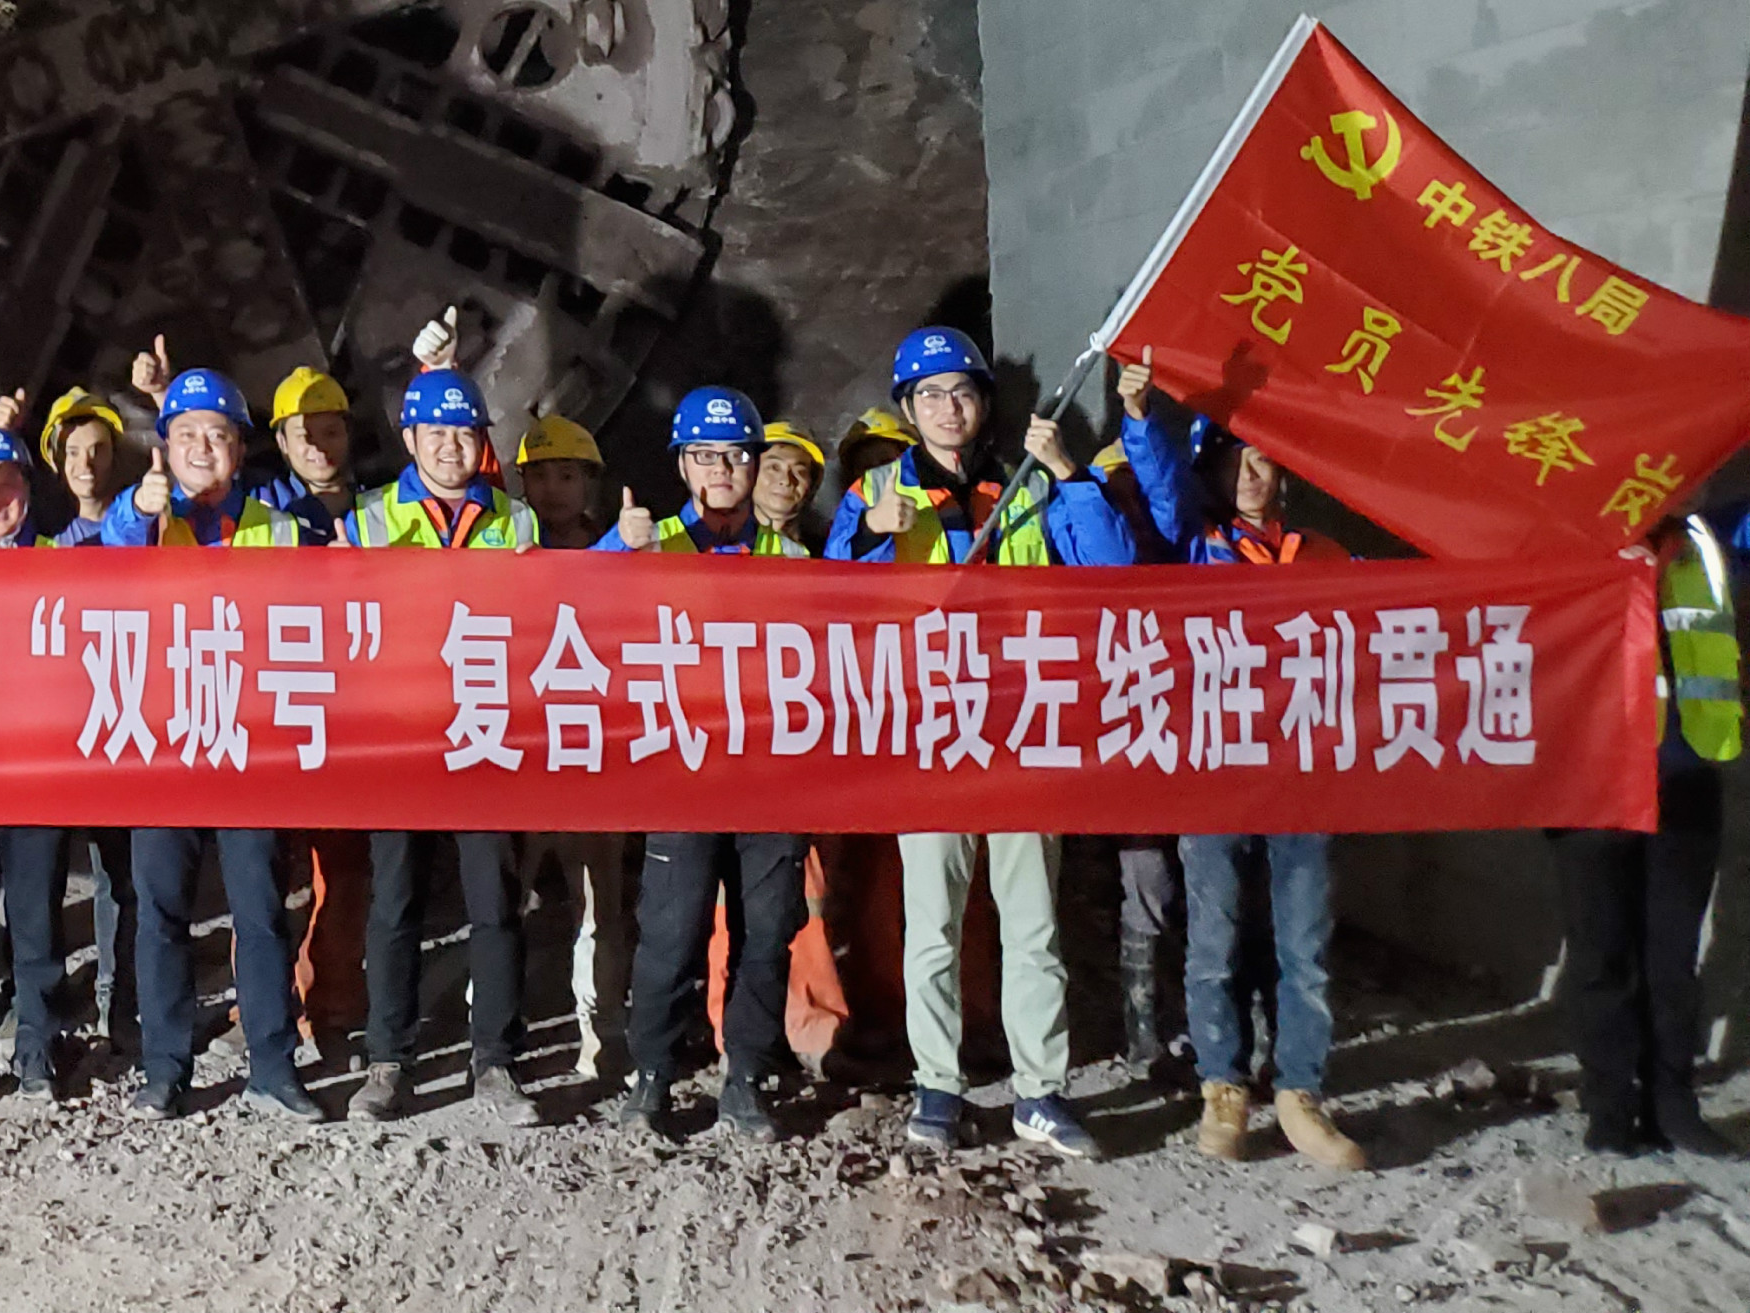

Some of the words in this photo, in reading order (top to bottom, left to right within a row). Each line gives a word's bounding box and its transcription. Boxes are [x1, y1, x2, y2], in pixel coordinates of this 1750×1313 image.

[1416, 180, 1651, 336] 中铁八局
[1219, 245, 1685, 536] 党员先锋岗
